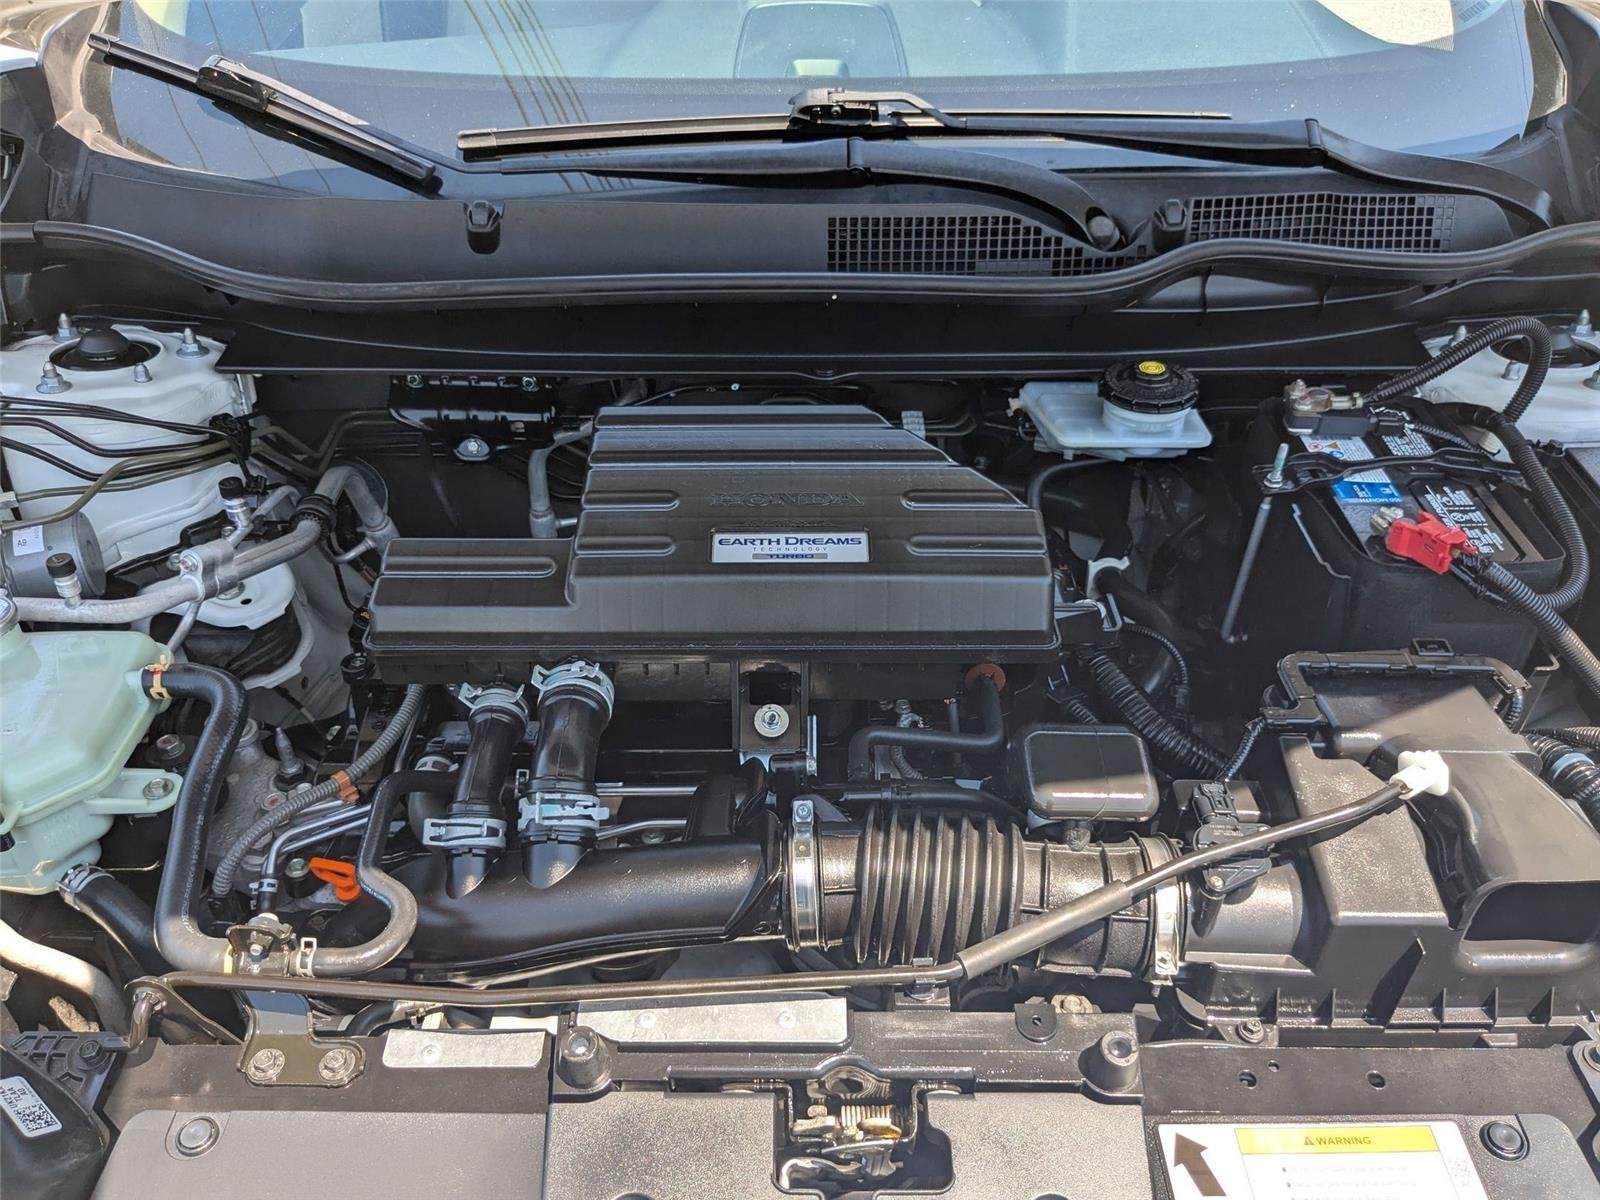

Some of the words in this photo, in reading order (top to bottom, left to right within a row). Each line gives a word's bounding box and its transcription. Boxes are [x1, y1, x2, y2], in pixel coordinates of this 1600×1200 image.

[710, 491, 865, 507] HONDA
[718, 537, 781, 546] EARTH
[784, 536, 862, 546] DREAMS
[1315, 1135, 1372, 1146] WARNING
